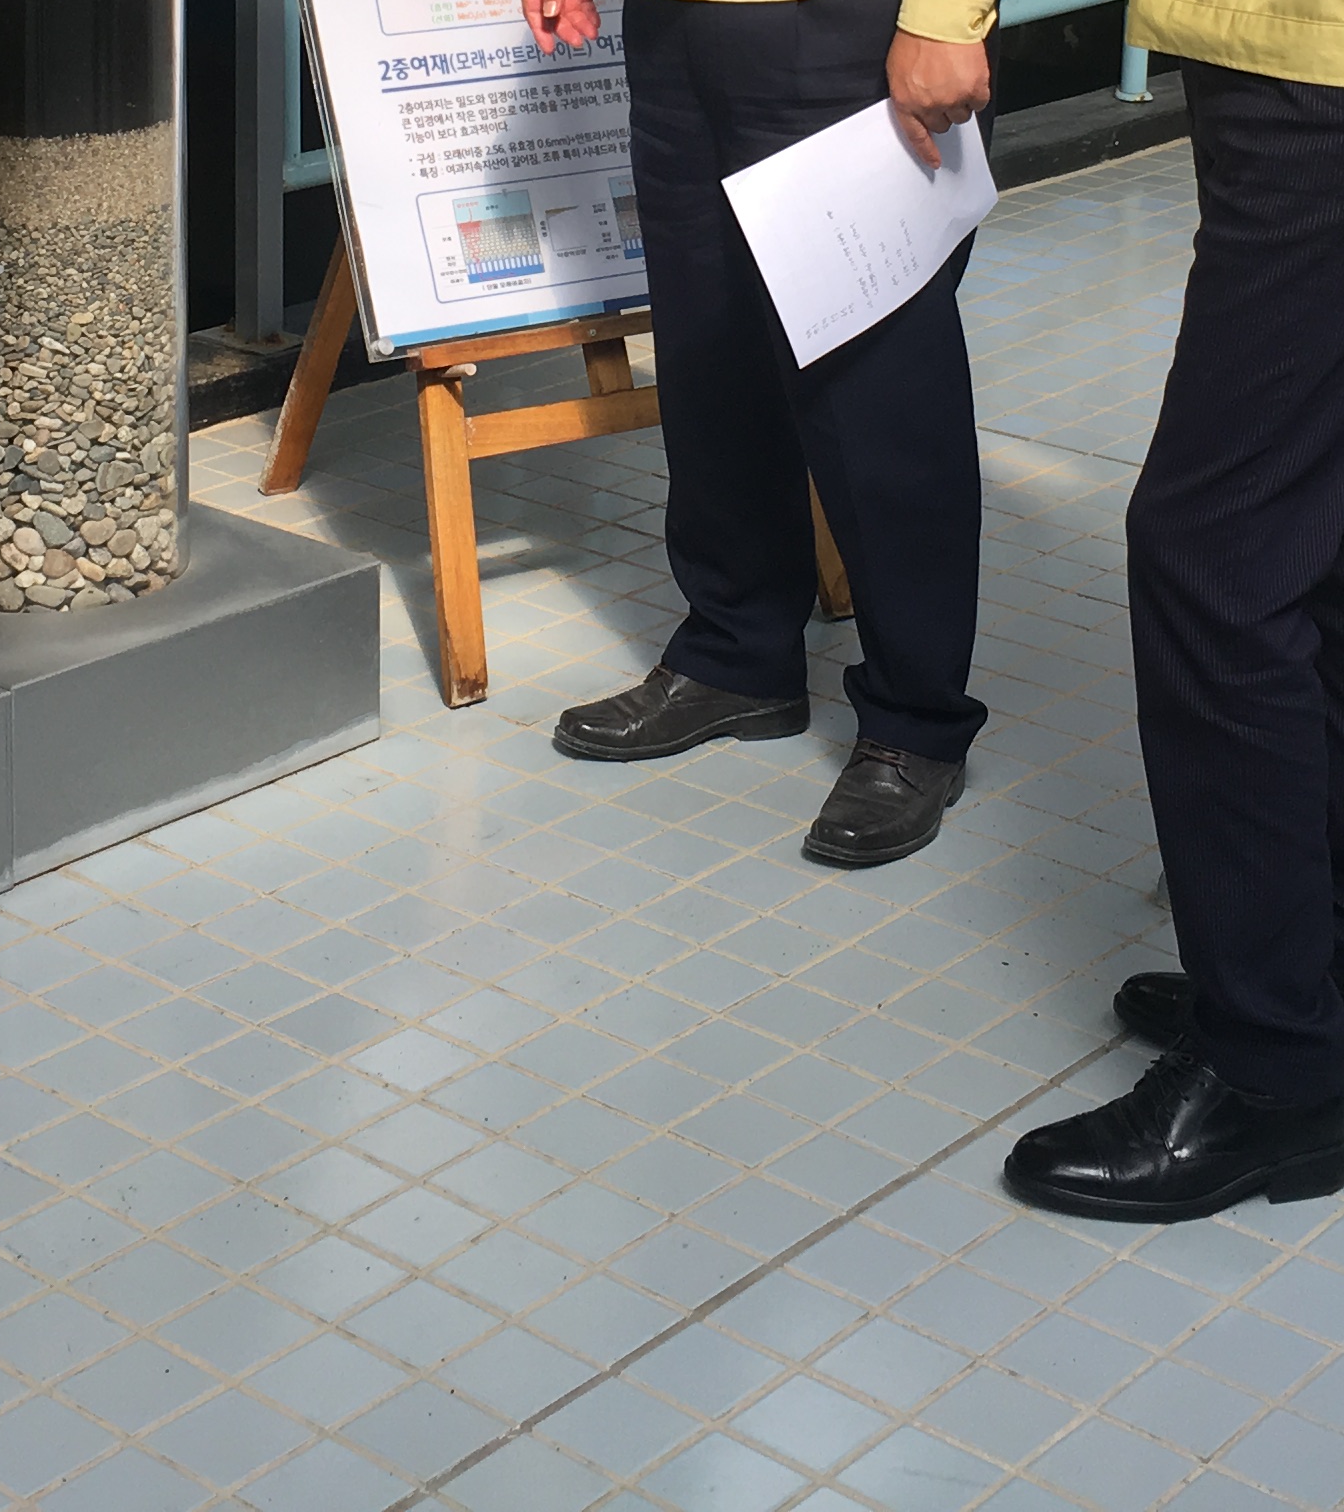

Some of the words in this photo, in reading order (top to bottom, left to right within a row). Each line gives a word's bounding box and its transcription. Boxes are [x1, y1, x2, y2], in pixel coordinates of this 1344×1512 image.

[377, 38, 592, 82] 2중여재(모래+안트라이)
[455, 93, 486, 109] 밀도와
[487, 90, 517, 105] 입경이
[519, 86, 539, 100] 다른
[541, 85, 551, 98] 두
[402, 117, 412, 130] 큰
[414, 113, 454, 129] 입경에서
[456, 109, 476, 123] 작은
[478, 104, 518, 121] 입경으로
[519, 99, 558, 115] 여과층을
[603, 91, 622, 105] 모래
[404, 129, 436, 144] 기능이
[437, 127, 458, 140] 보다
[416, 152, 436, 165] 구성
